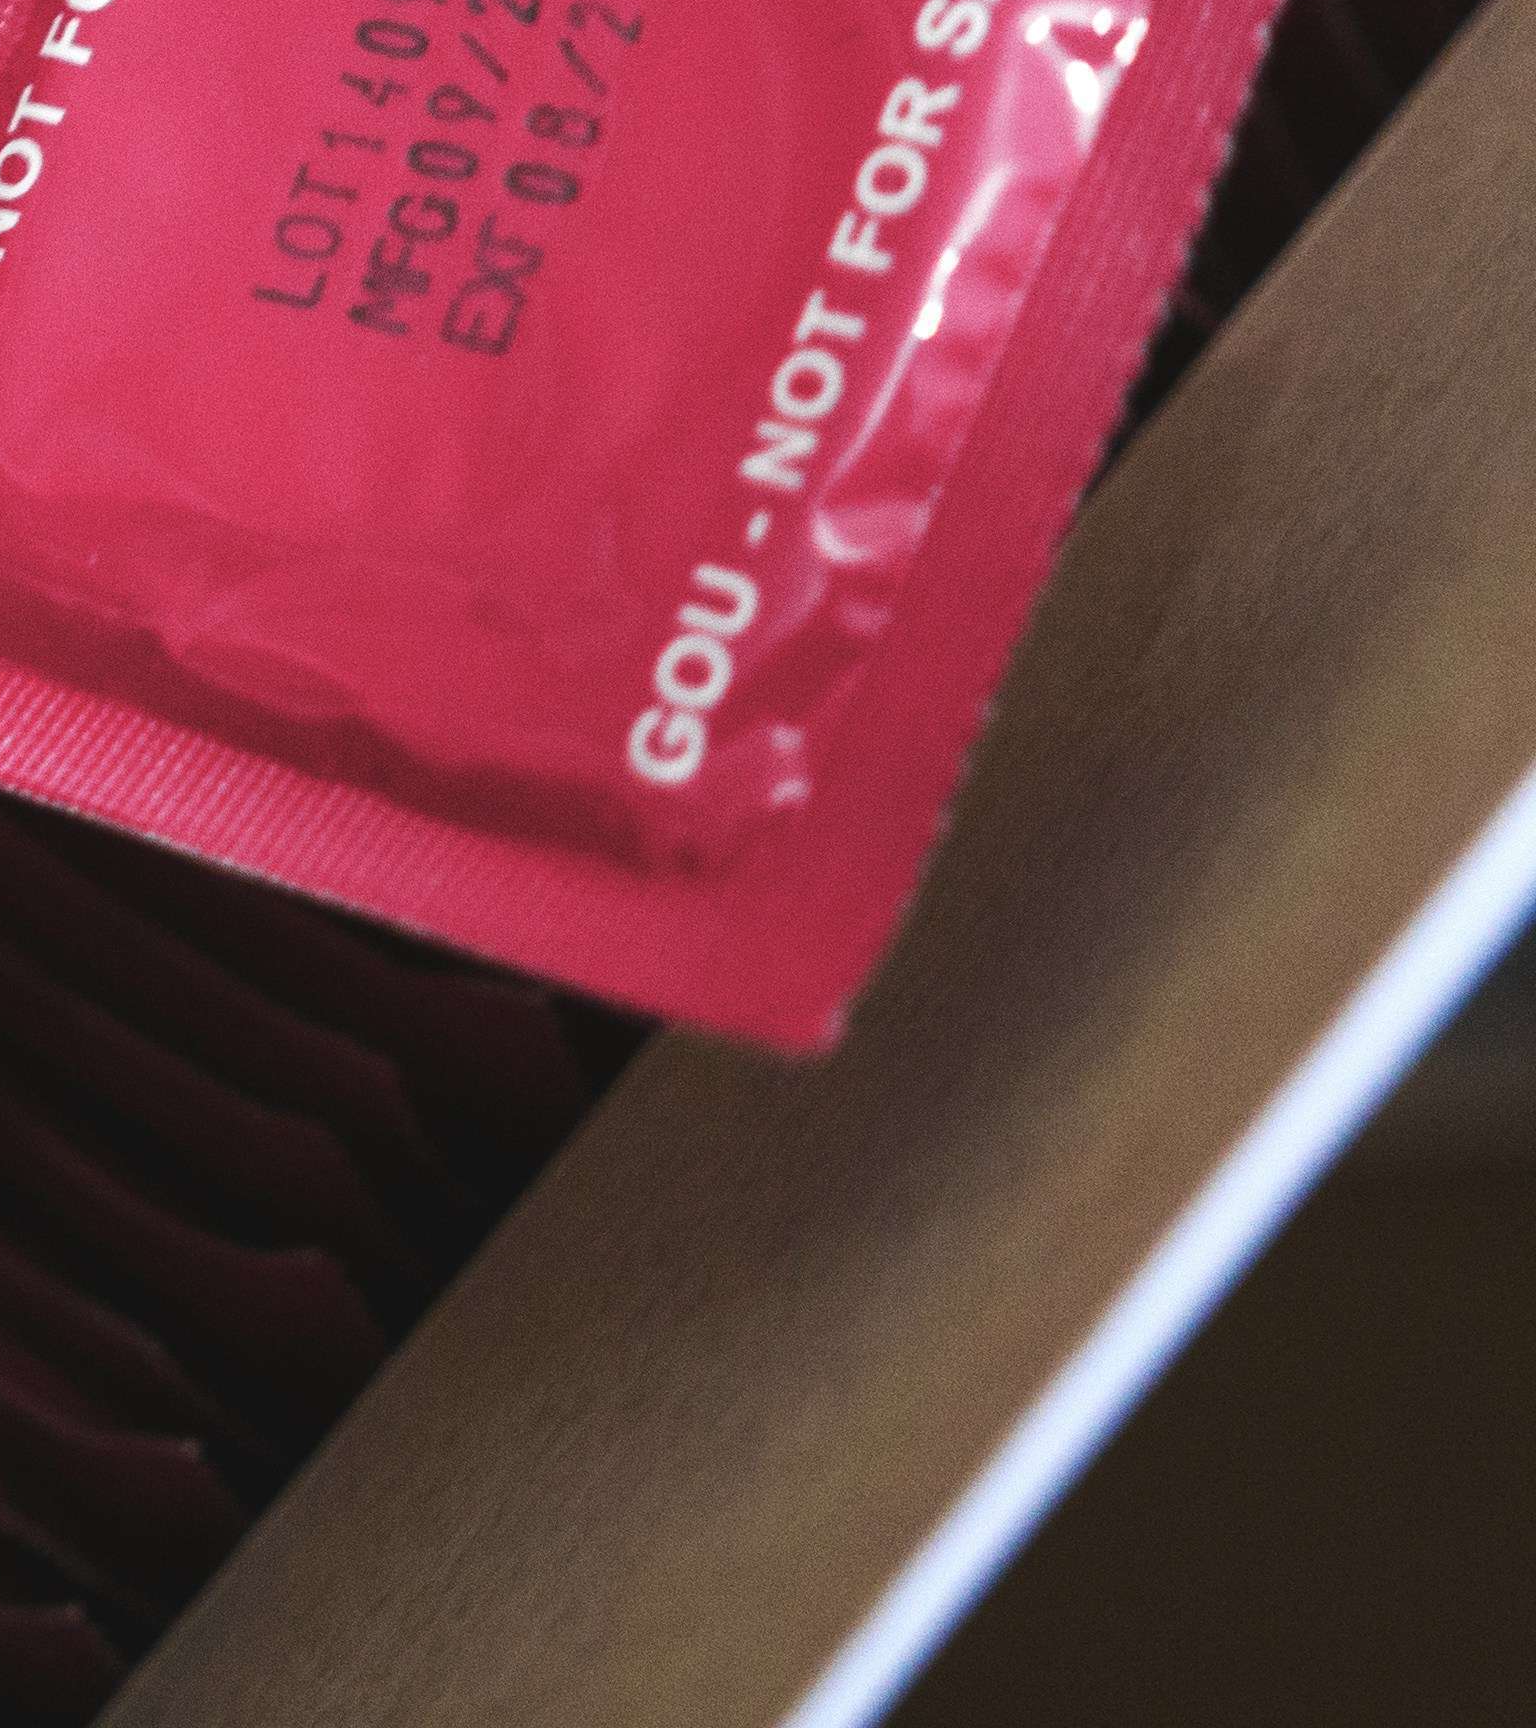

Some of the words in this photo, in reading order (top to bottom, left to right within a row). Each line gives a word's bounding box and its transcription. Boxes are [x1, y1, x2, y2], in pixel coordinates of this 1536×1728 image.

[828, 77, 963, 274] FOR
[739, 290, 866, 490] NOT
[746, 511, 770, 547] -
[629, 564, 759, 786] GOU
